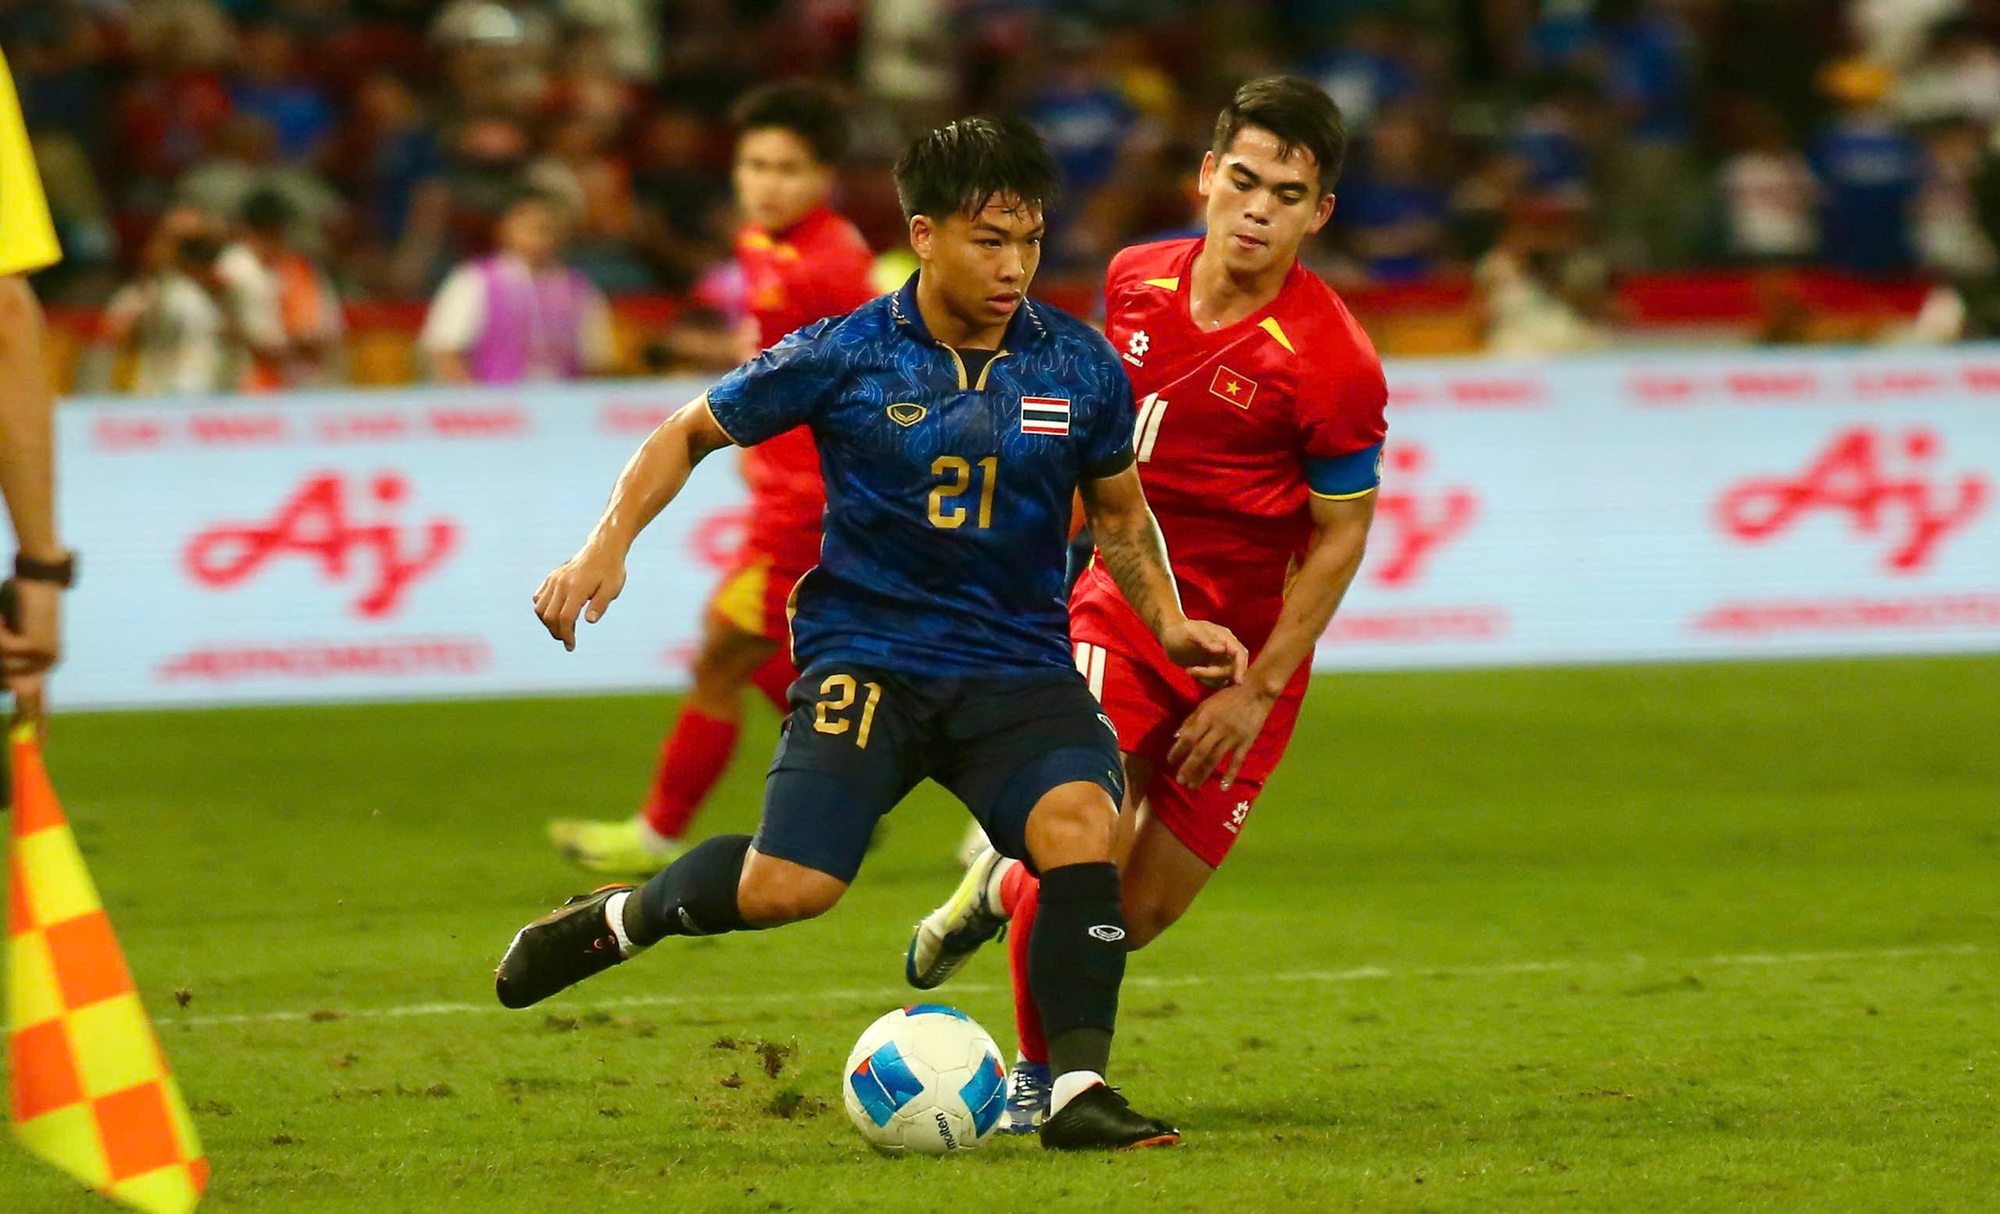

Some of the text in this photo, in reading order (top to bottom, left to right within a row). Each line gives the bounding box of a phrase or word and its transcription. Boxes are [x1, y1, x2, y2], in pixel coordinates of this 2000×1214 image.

[927, 455, 997, 530] 21
[813, 674, 882, 749] 21
[935, 1112, 957, 1150] molten
